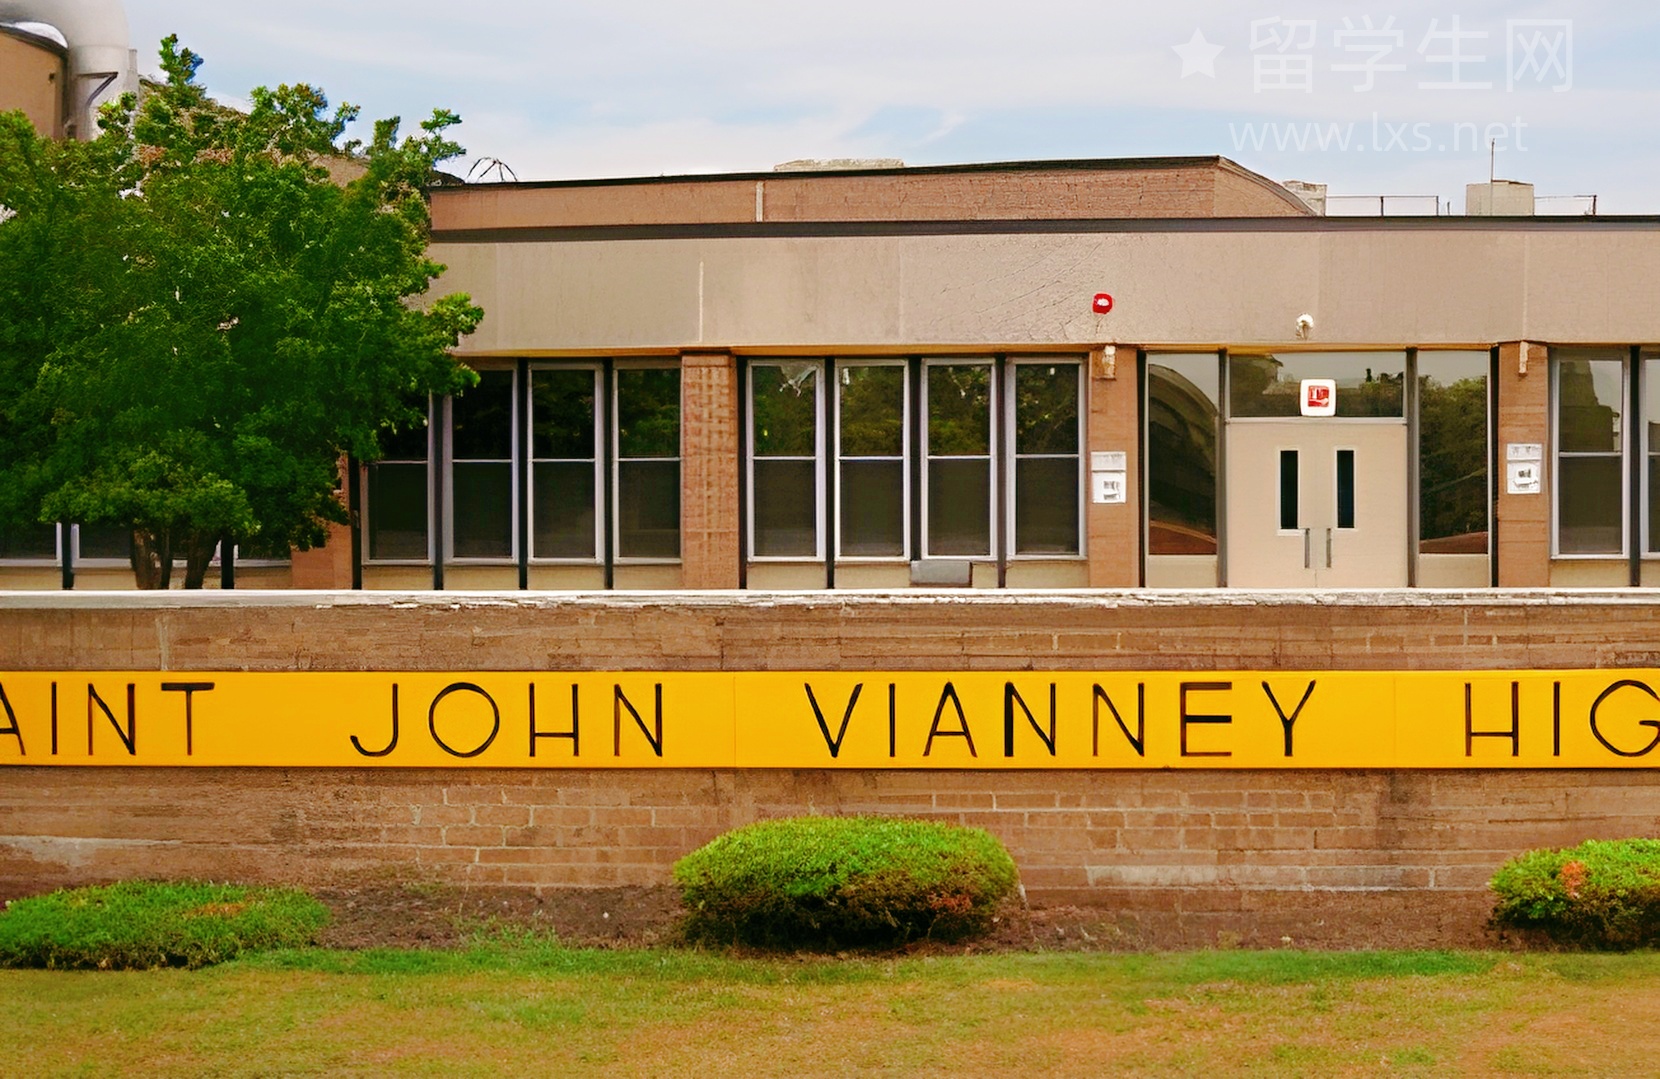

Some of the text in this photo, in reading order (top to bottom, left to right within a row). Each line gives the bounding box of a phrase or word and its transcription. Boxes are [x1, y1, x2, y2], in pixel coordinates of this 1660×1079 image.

[350, 681, 663, 758] JOHN
[804, 680, 1316, 758] VIANNEY
[1465, 679, 1660, 758] HIG
